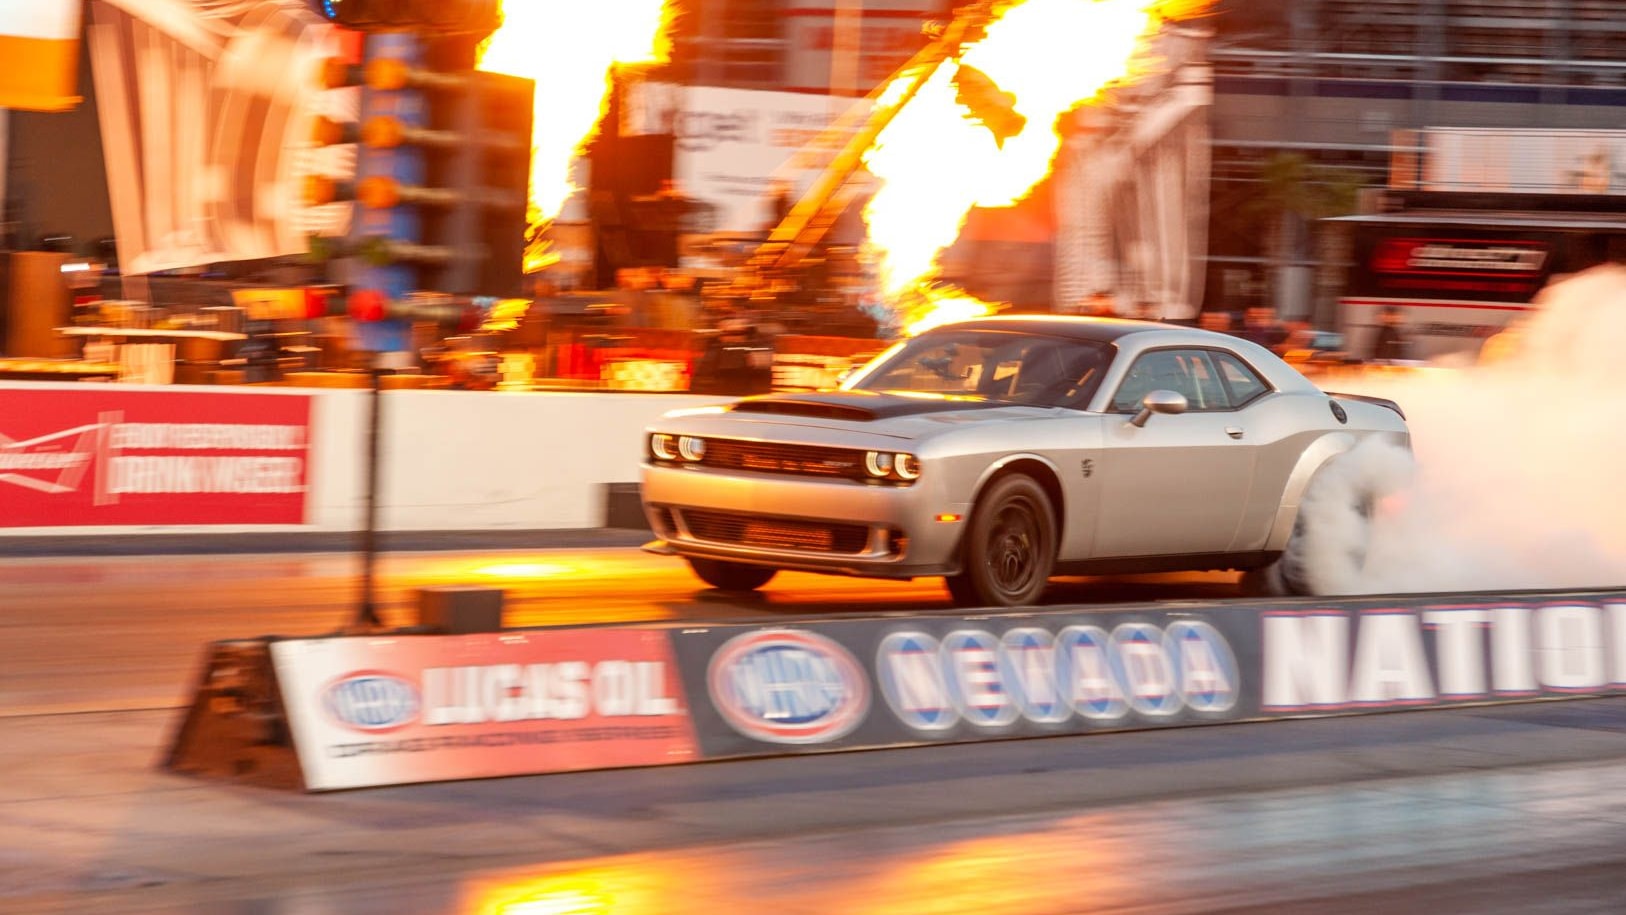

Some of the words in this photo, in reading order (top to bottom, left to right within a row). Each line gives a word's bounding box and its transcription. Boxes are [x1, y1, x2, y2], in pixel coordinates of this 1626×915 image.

[422, 662, 590, 726] LUCAS
[593, 659, 680, 717] OIL
[885, 638, 1234, 711] NEVADA
[1259, 600, 1626, 711] NATIO
